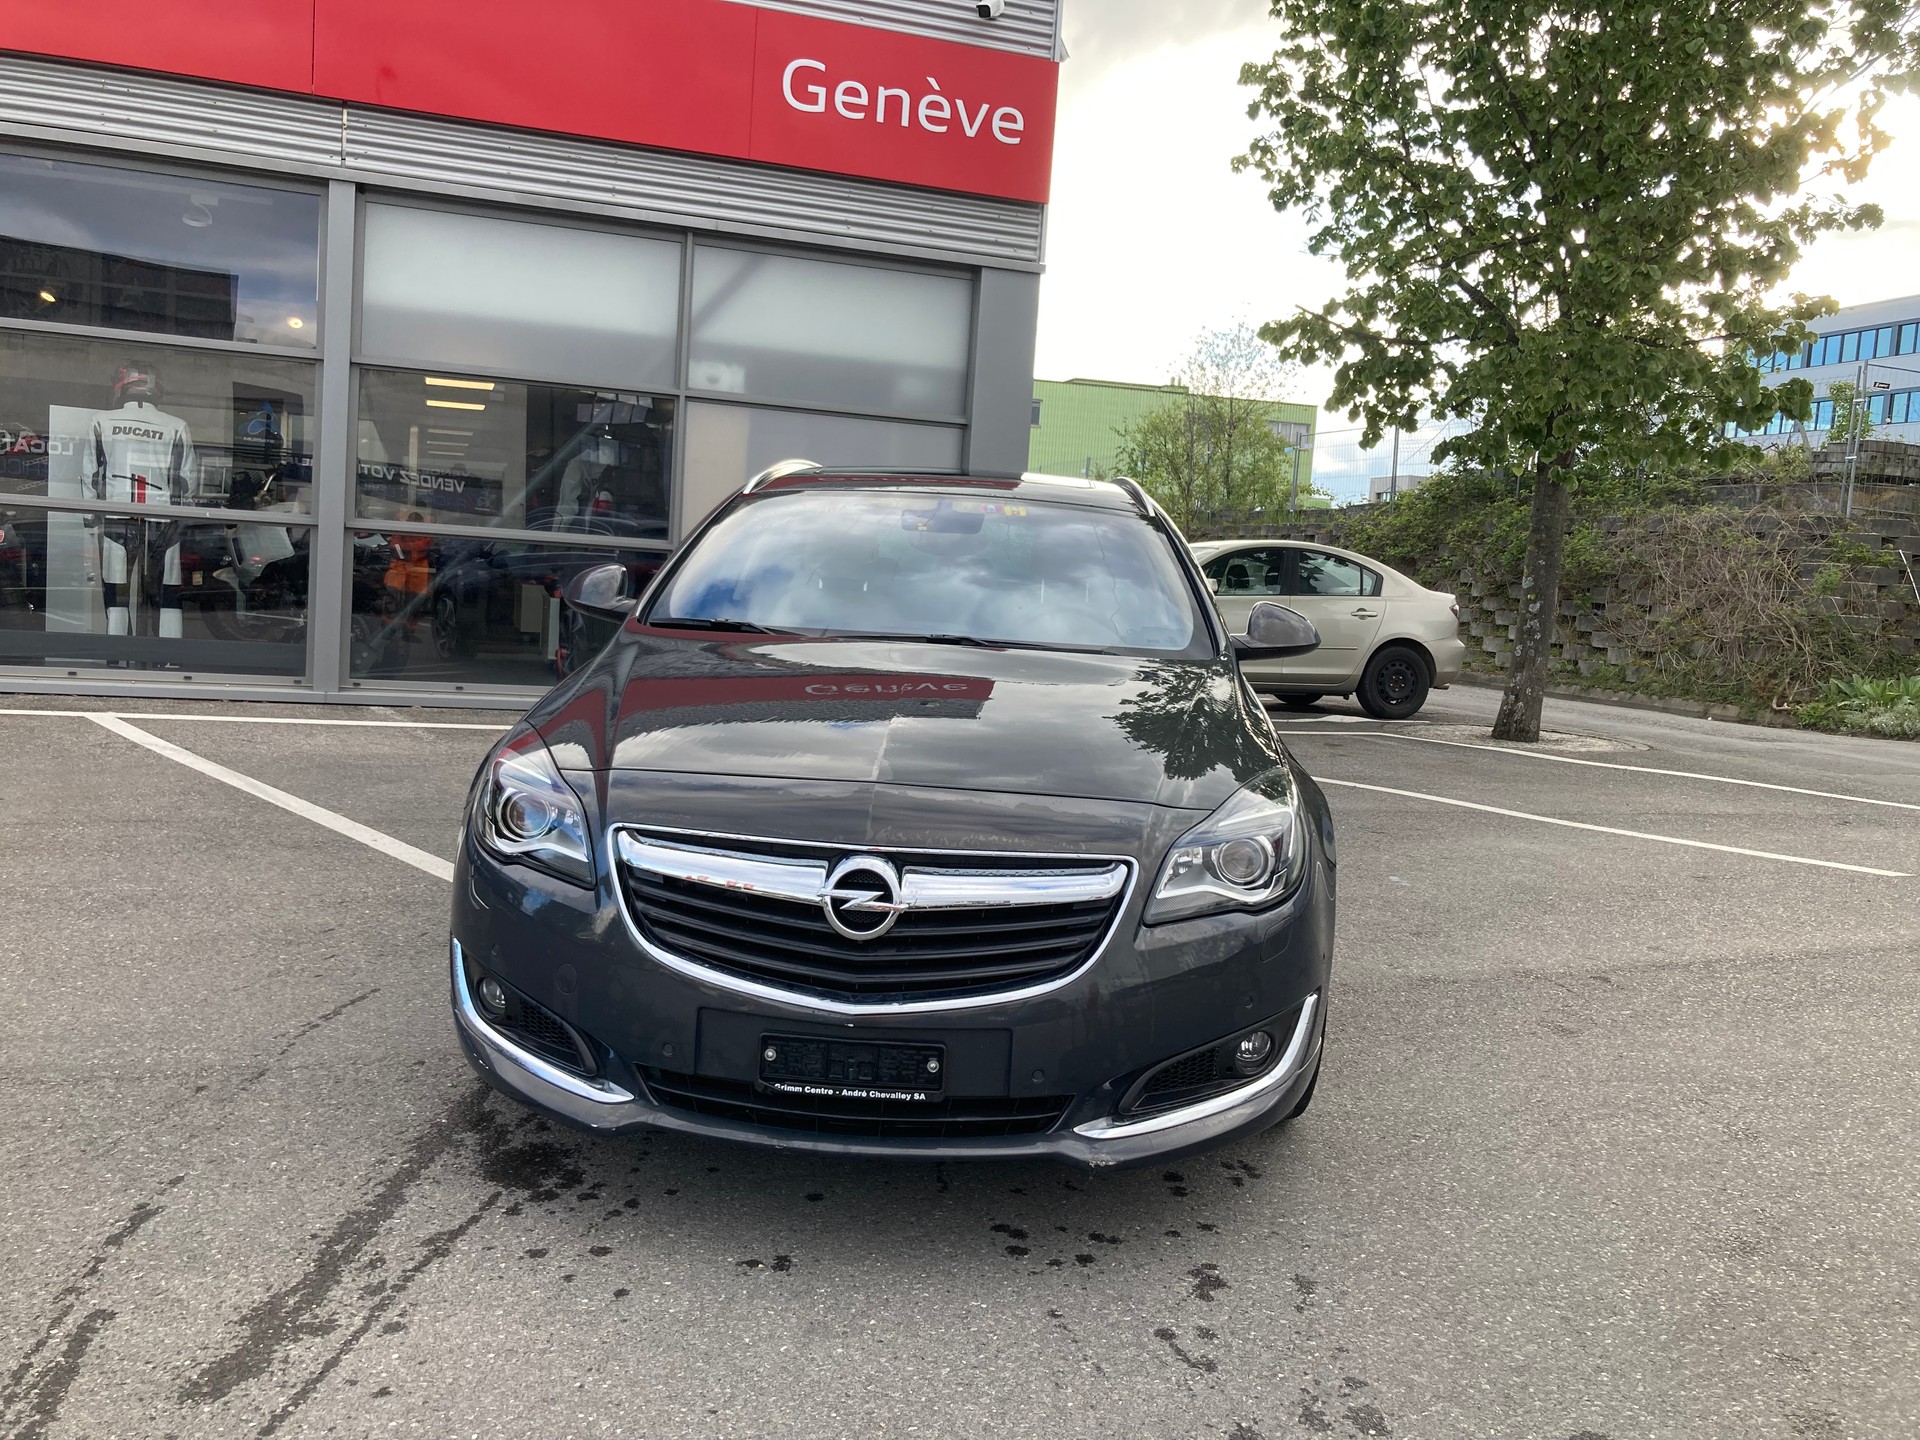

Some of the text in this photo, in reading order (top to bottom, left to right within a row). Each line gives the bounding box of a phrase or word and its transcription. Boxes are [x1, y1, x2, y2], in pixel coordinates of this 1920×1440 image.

[782, 59, 1024, 144] Genève
[112, 426, 164, 440] DUCATI
[804, 1086, 834, 1095] Centre
[841, 1089, 867, 1097] André
[869, 1090, 911, 1101] Chevalley
[913, 1092, 926, 1100] SA
